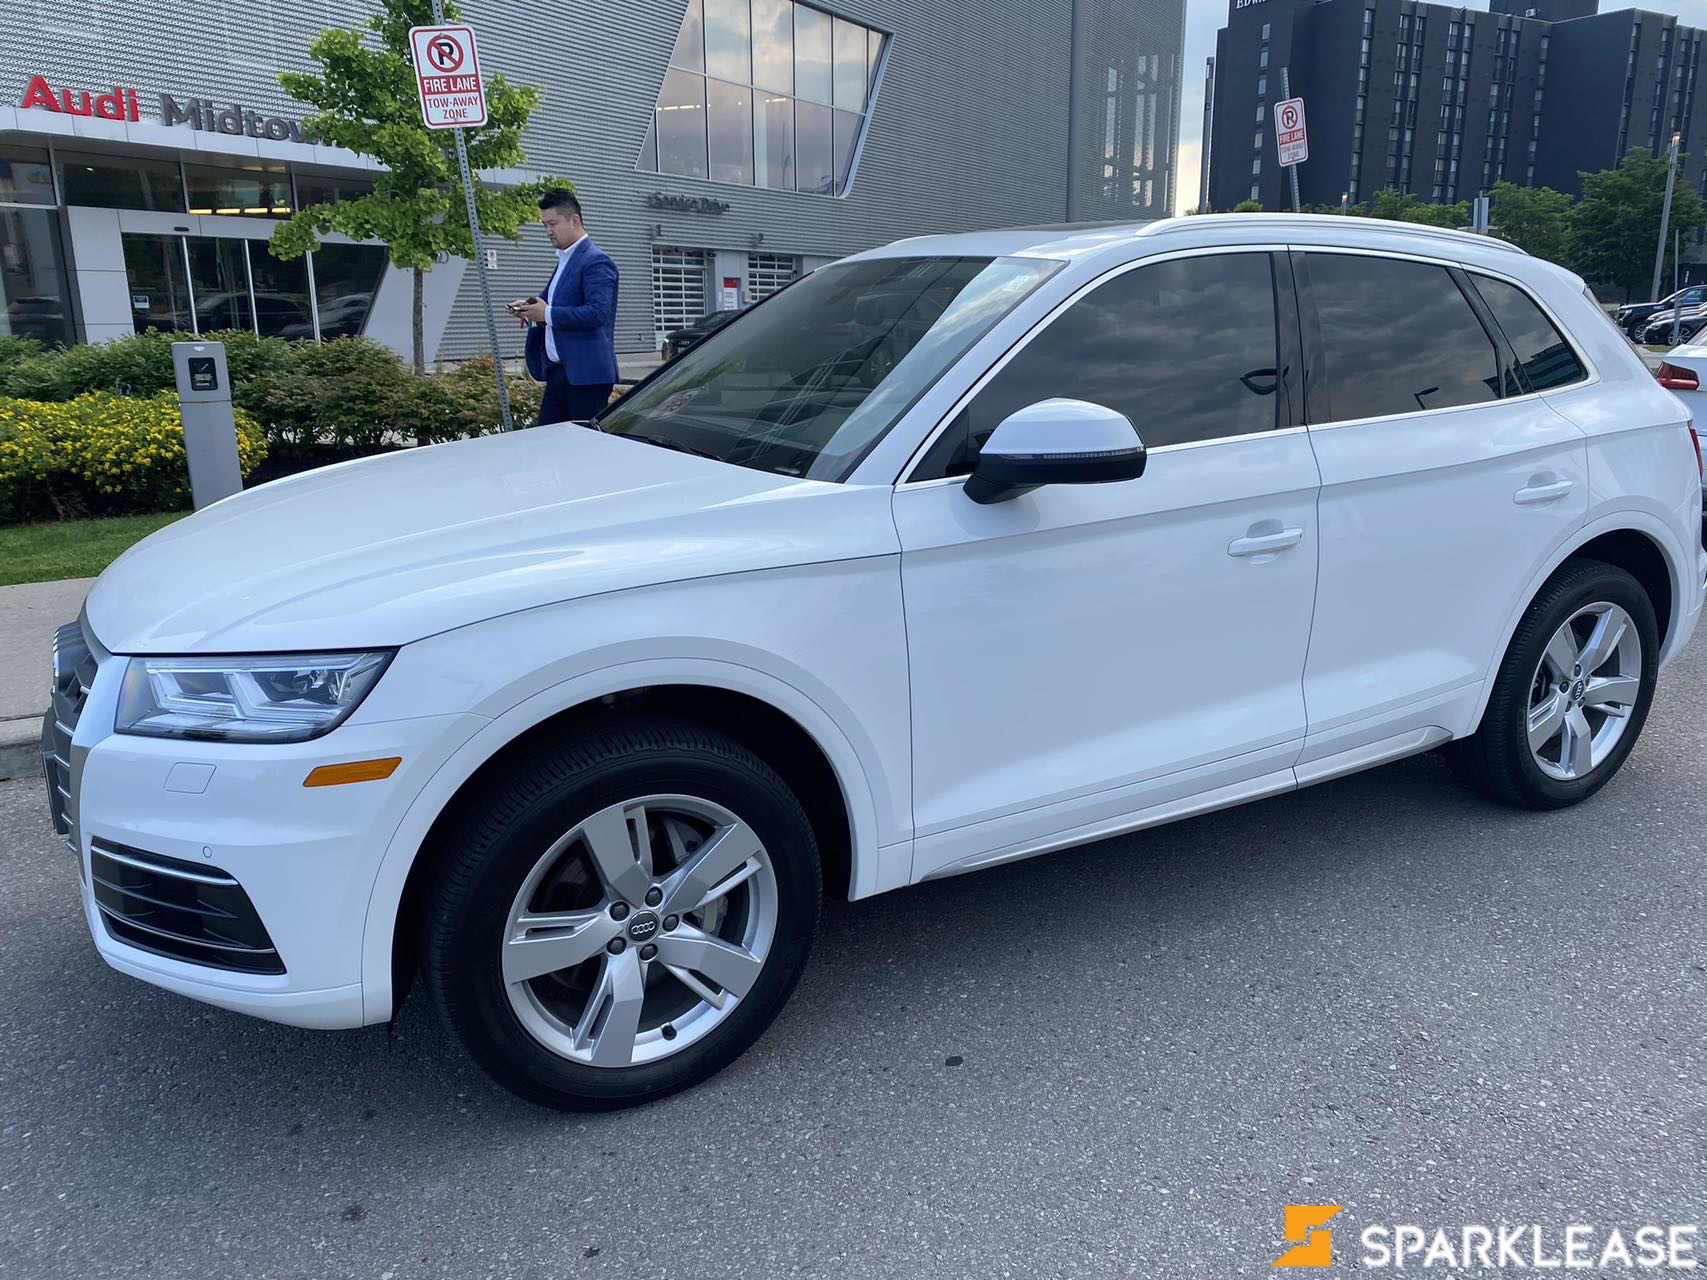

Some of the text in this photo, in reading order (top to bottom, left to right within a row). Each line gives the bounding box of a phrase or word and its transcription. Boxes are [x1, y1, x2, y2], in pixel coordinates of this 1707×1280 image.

[423, 77, 477, 93] FIRE LANE
[428, 96, 478, 108] TOW-AWAY
[21, 75, 320, 144] Audi Midtow
[443, 108, 468, 119] ZONE
